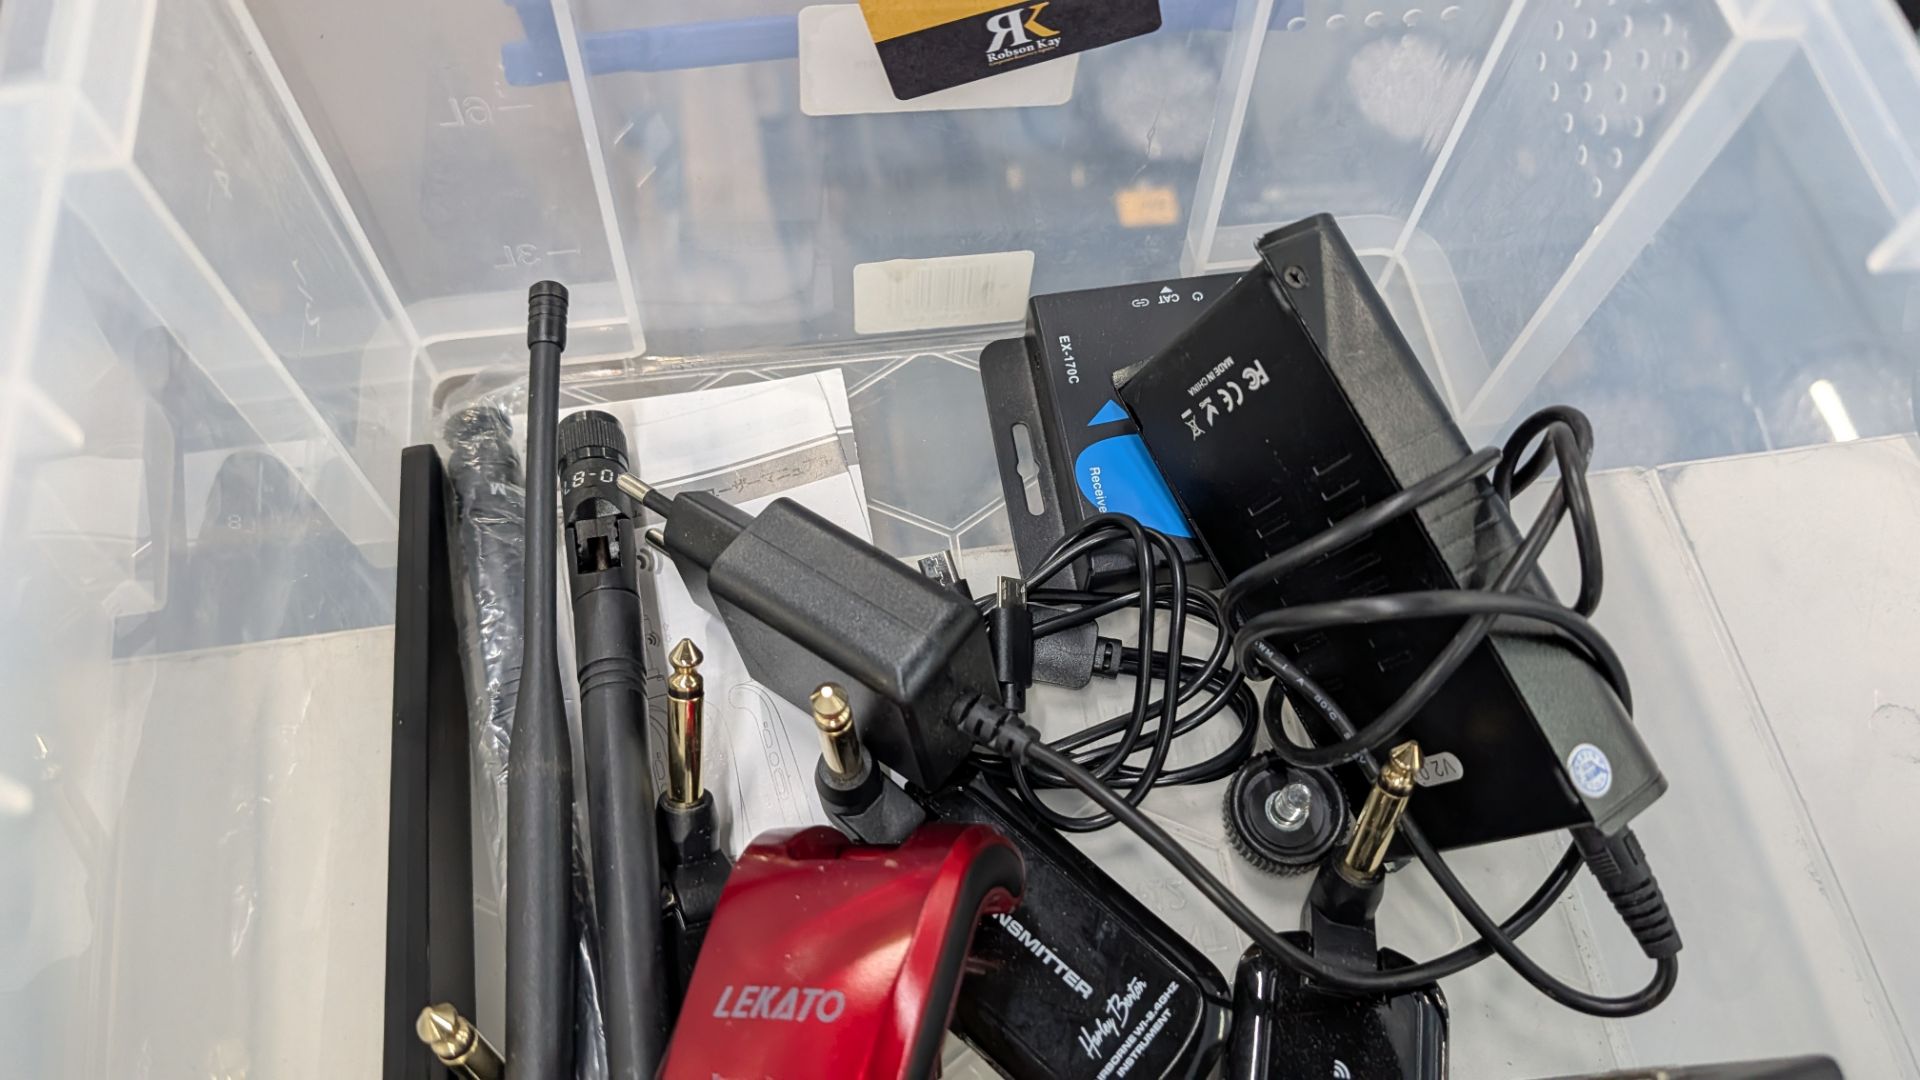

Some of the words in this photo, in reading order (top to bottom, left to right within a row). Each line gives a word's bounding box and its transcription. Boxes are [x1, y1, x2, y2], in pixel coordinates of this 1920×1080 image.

[986, 45, 1035, 63] Robson
[1037, 37, 1061, 53] Kay
[1158, 293, 1180, 305] CAT
[1059, 335, 1080, 385] EX-170C
[1205, 370, 1217, 382] IN
[1213, 356, 1234, 377] MADE
[1187, 376, 1209, 397] CHINA
[1090, 466, 1108, 514] Receive
[1254, 640, 1275, 658] WM
[993, 912, 1094, 1000] NSMITTER
[712, 985, 846, 1023] LEKATO
[1094, 1033, 1138, 1080] IRBORNE
[1116, 1007, 1172, 1078] INSTRUMENT
